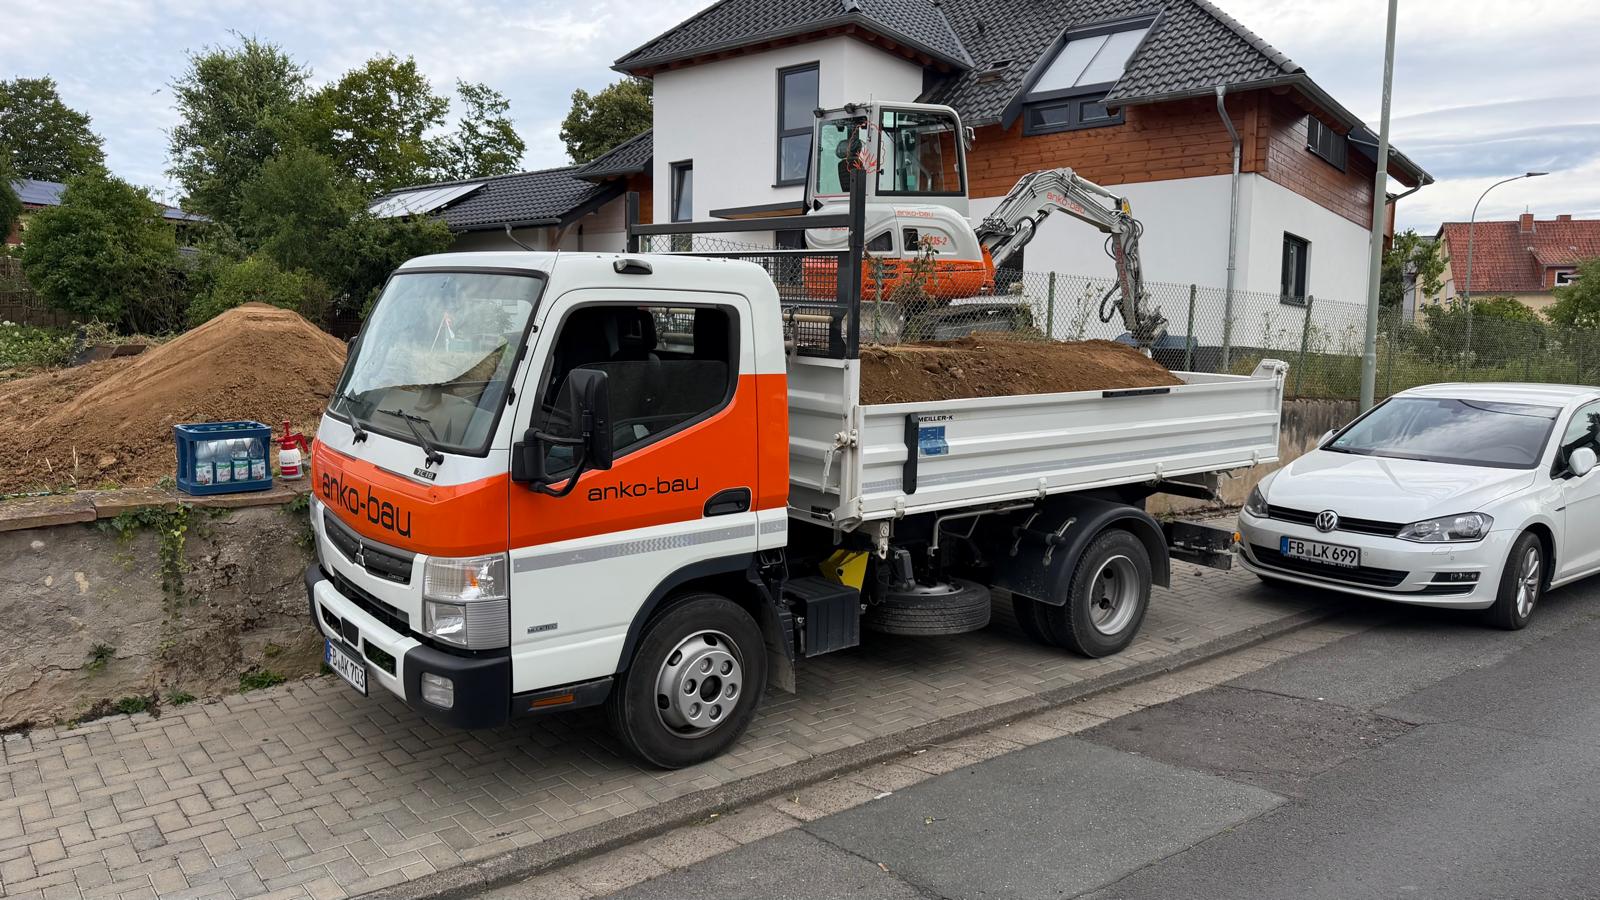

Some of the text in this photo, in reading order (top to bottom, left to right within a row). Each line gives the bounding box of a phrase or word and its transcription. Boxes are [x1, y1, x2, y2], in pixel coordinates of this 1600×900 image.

[588, 476, 699, 501] anko-bau
[322, 472, 411, 538] anko-bau
[1289, 541, 1304, 555] FB
[1313, 544, 1329, 559] LK
[1332, 547, 1357, 564] 699
[350, 662, 364, 688] 703
